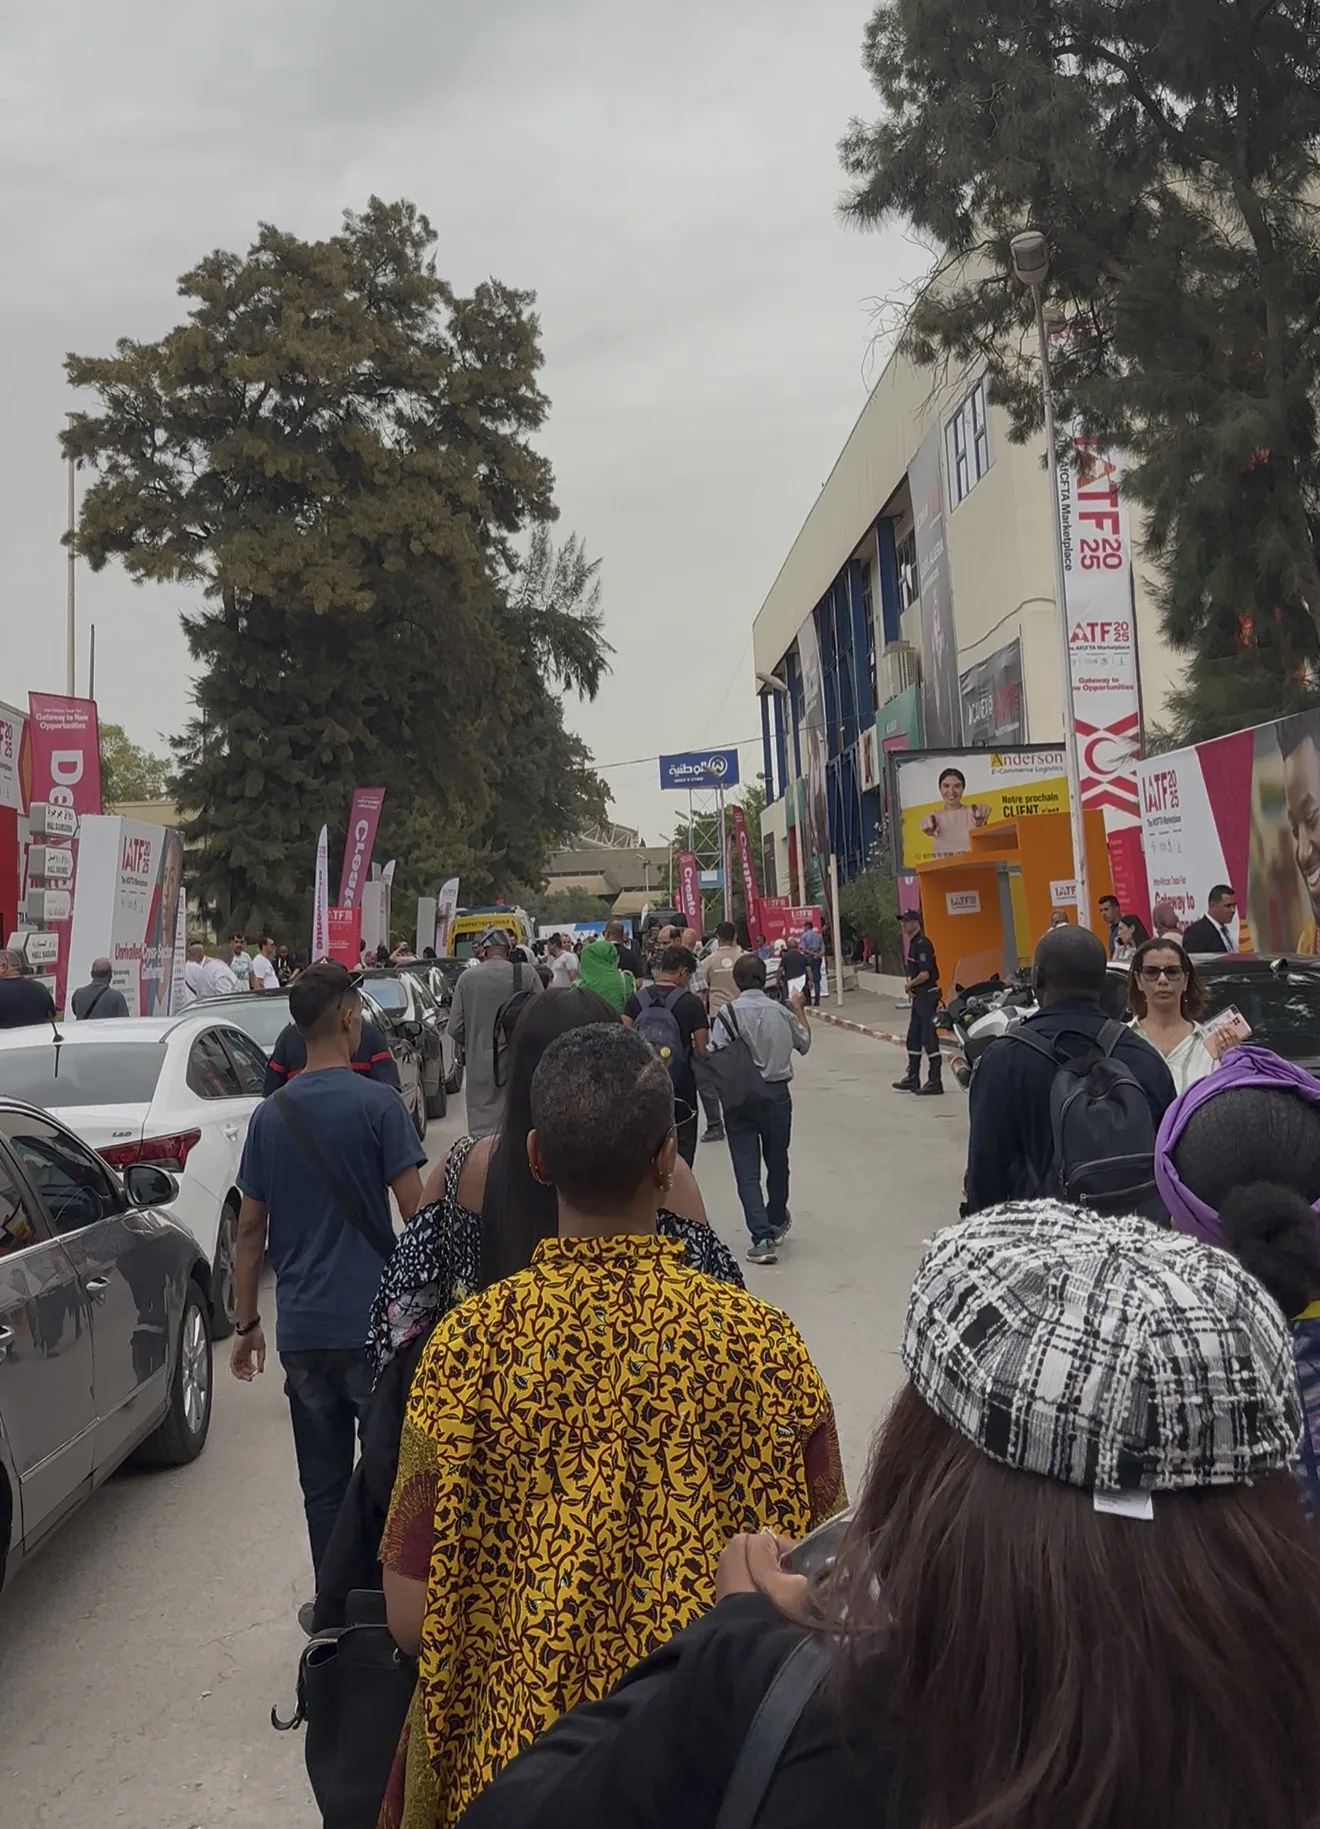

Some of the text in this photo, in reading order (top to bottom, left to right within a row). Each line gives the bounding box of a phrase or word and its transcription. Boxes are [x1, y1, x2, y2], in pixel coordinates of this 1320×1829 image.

[1061, 503, 1074, 571] Marketplace
[1079, 538, 1101, 569] 25
[1101, 538, 1123, 569] 20
[1070, 621, 1129, 643] ATF 20
[1114, 632, 1130, 642] 25
[1078, 677, 1111, 686] Gateway
[1082, 684, 1135, 692] Opportunities
[36, 713, 66, 723] Gateway
[66, 713, 73, 721] to
[39, 721, 86, 731] Opportunities
[991, 752, 1063, 767] Anderson
[1034, 765, 1064, 774] Logistics
[1001, 793, 1059, 805] Notre prochain
[1142, 769, 1177, 814] IATF 20
[1170, 789, 1180, 809] 25
[1002, 804, 1039, 819] CLIENT
[121, 836, 145, 873] IATF
[1186, 891, 1195, 910] to
